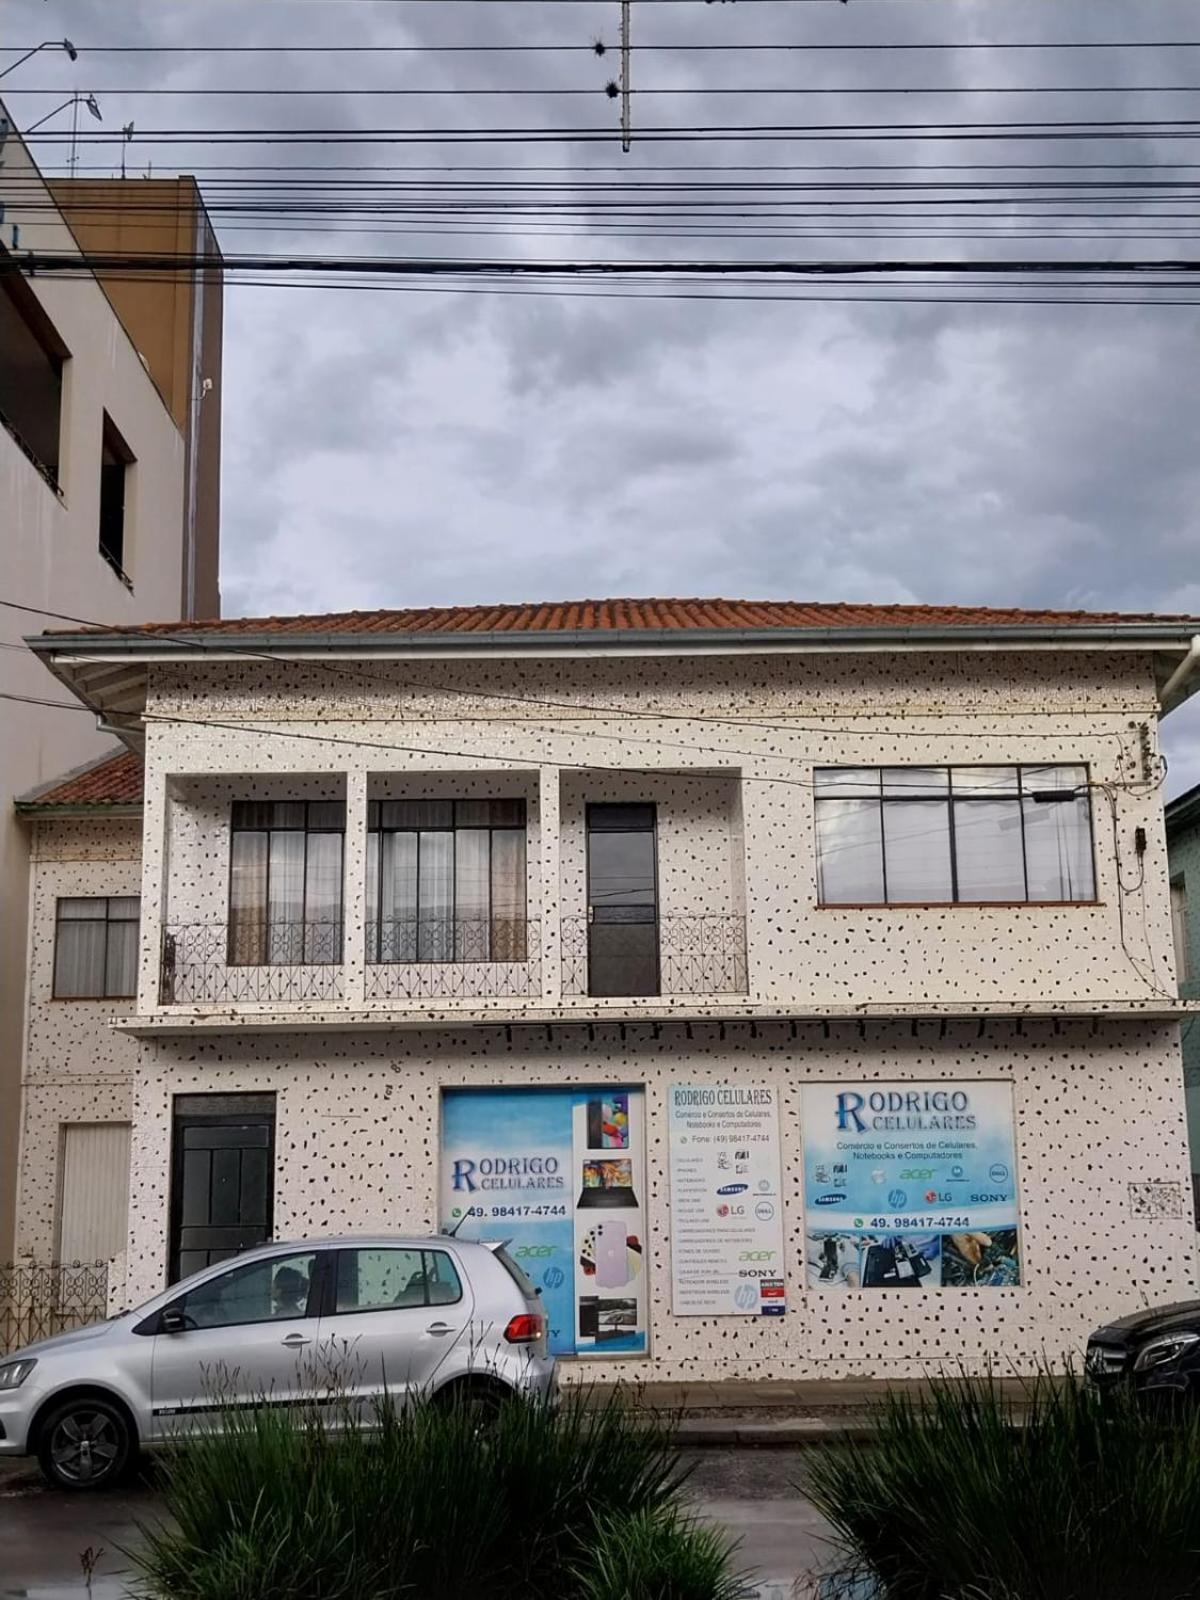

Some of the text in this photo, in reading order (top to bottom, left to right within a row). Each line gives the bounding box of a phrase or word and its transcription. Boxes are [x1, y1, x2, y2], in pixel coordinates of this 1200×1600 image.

[674, 1089, 773, 1106] RODRIGO CELULARES
[835, 1090, 969, 1134] RODRIGO
[872, 1115, 977, 1132] CELULARES
[713, 1135, 728, 1144] (49)
[729, 1134, 770, 1143] 98417-4744
[876, 1143, 882, 1151] e
[883, 1141, 925, 1150] Consertos
[926, 1141, 937, 1150] de
[853, 1151, 896, 1161] Notebooks
[904, 1151, 963, 1161] Computadores
[452, 1156, 559, 1193] RODRIGO
[900, 1168, 939, 1180] acer
[481, 1176, 565, 1191] CELULARES
[938, 1192, 953, 1202] LG
[970, 1193, 1008, 1202] SONY
[491, 1205, 567, 1217] 98417-4744
[730, 1205, 746, 1216] LG
[870, 1216, 971, 1228] 49. 98417-4744
[515, 1244, 559, 1258] acer
[738, 1250, 777, 1262] acer
[738, 1269, 777, 1278] SONY
